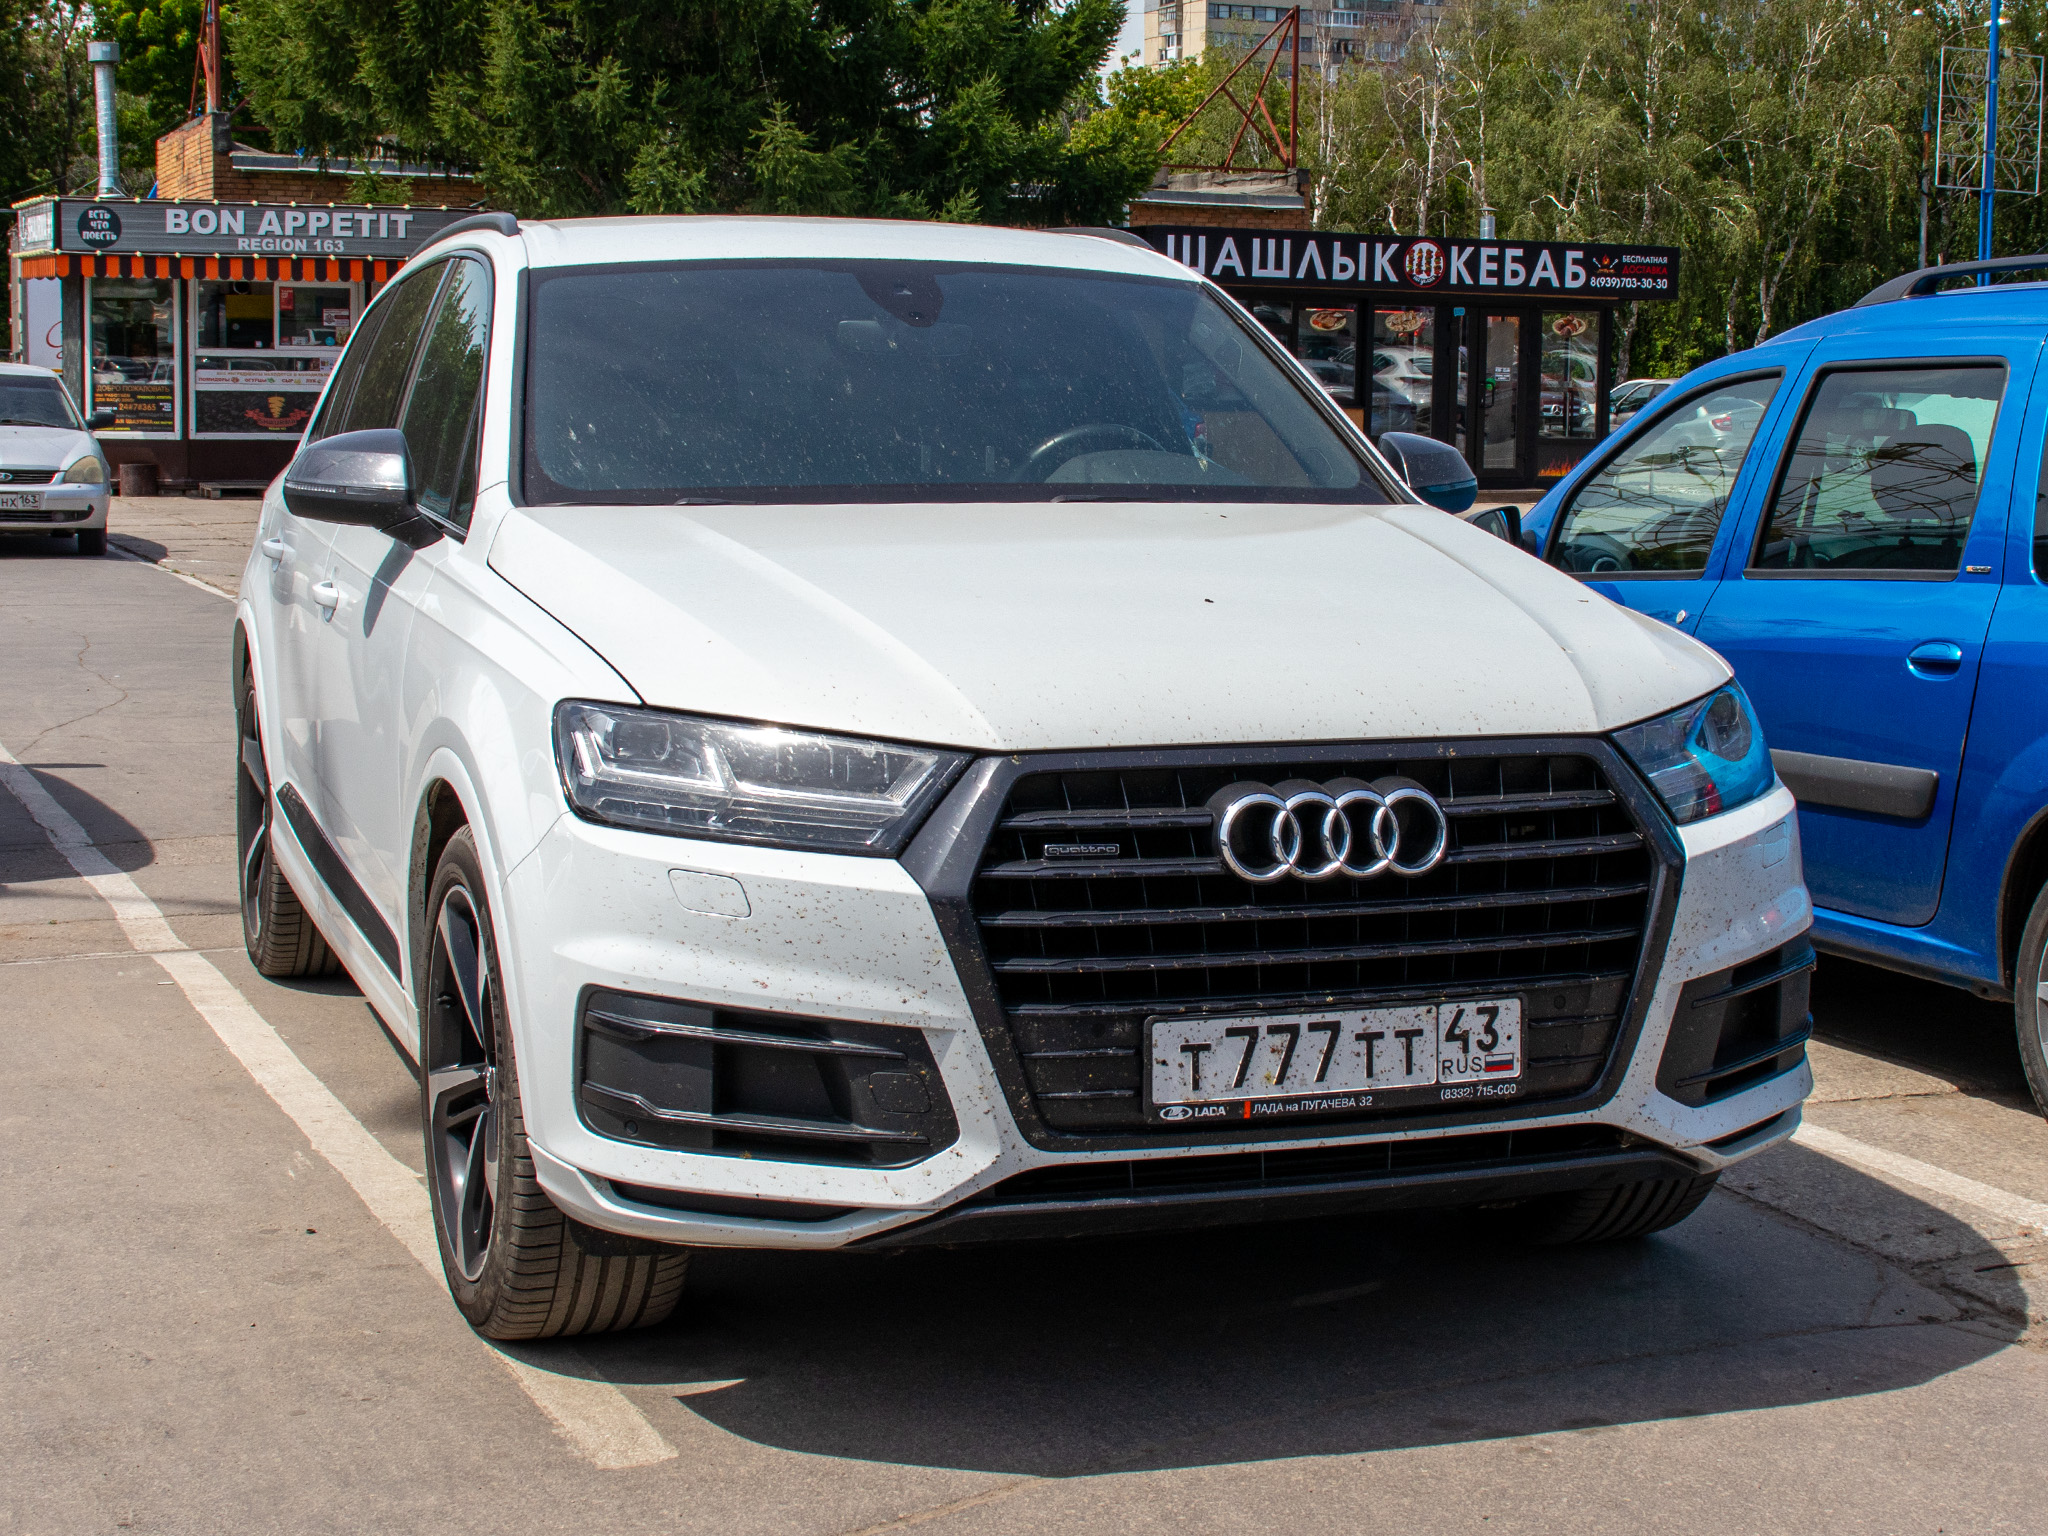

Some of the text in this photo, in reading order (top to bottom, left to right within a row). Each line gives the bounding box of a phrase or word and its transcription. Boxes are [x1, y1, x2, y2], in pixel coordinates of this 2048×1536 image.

[88, 210, 111, 219] ЕСТЬ
[90, 221, 110, 230] ЧТО
[165, 208, 414, 239] BON APPETIT
[82, 231, 117, 241] ПОЕСТЬ
[237, 238, 345, 253] REGION 163
[1167, 235, 1587, 289] ШАШЛЫК КЕБАБ
[1622, 255, 1668, 264] БЕСПЛАТНАЯ
[1622, 265, 1668, 275] ДОСТАВКА
[1590, 276, 1668, 289] 8(939)703-30-30
[96, 384, 121, 392] ДОБРО
[19, 494, 39, 504] 163
[1048, 845, 1116, 856] quattro
[1179, 1005, 1500, 1092] Т777ТТ 43
[1441, 1057, 1483, 1076] RUS
[1252, 1095, 1373, 1115] ЛАДА на ПУГАЧЕВА 32
[1194, 1106, 1227, 1117] LADA
